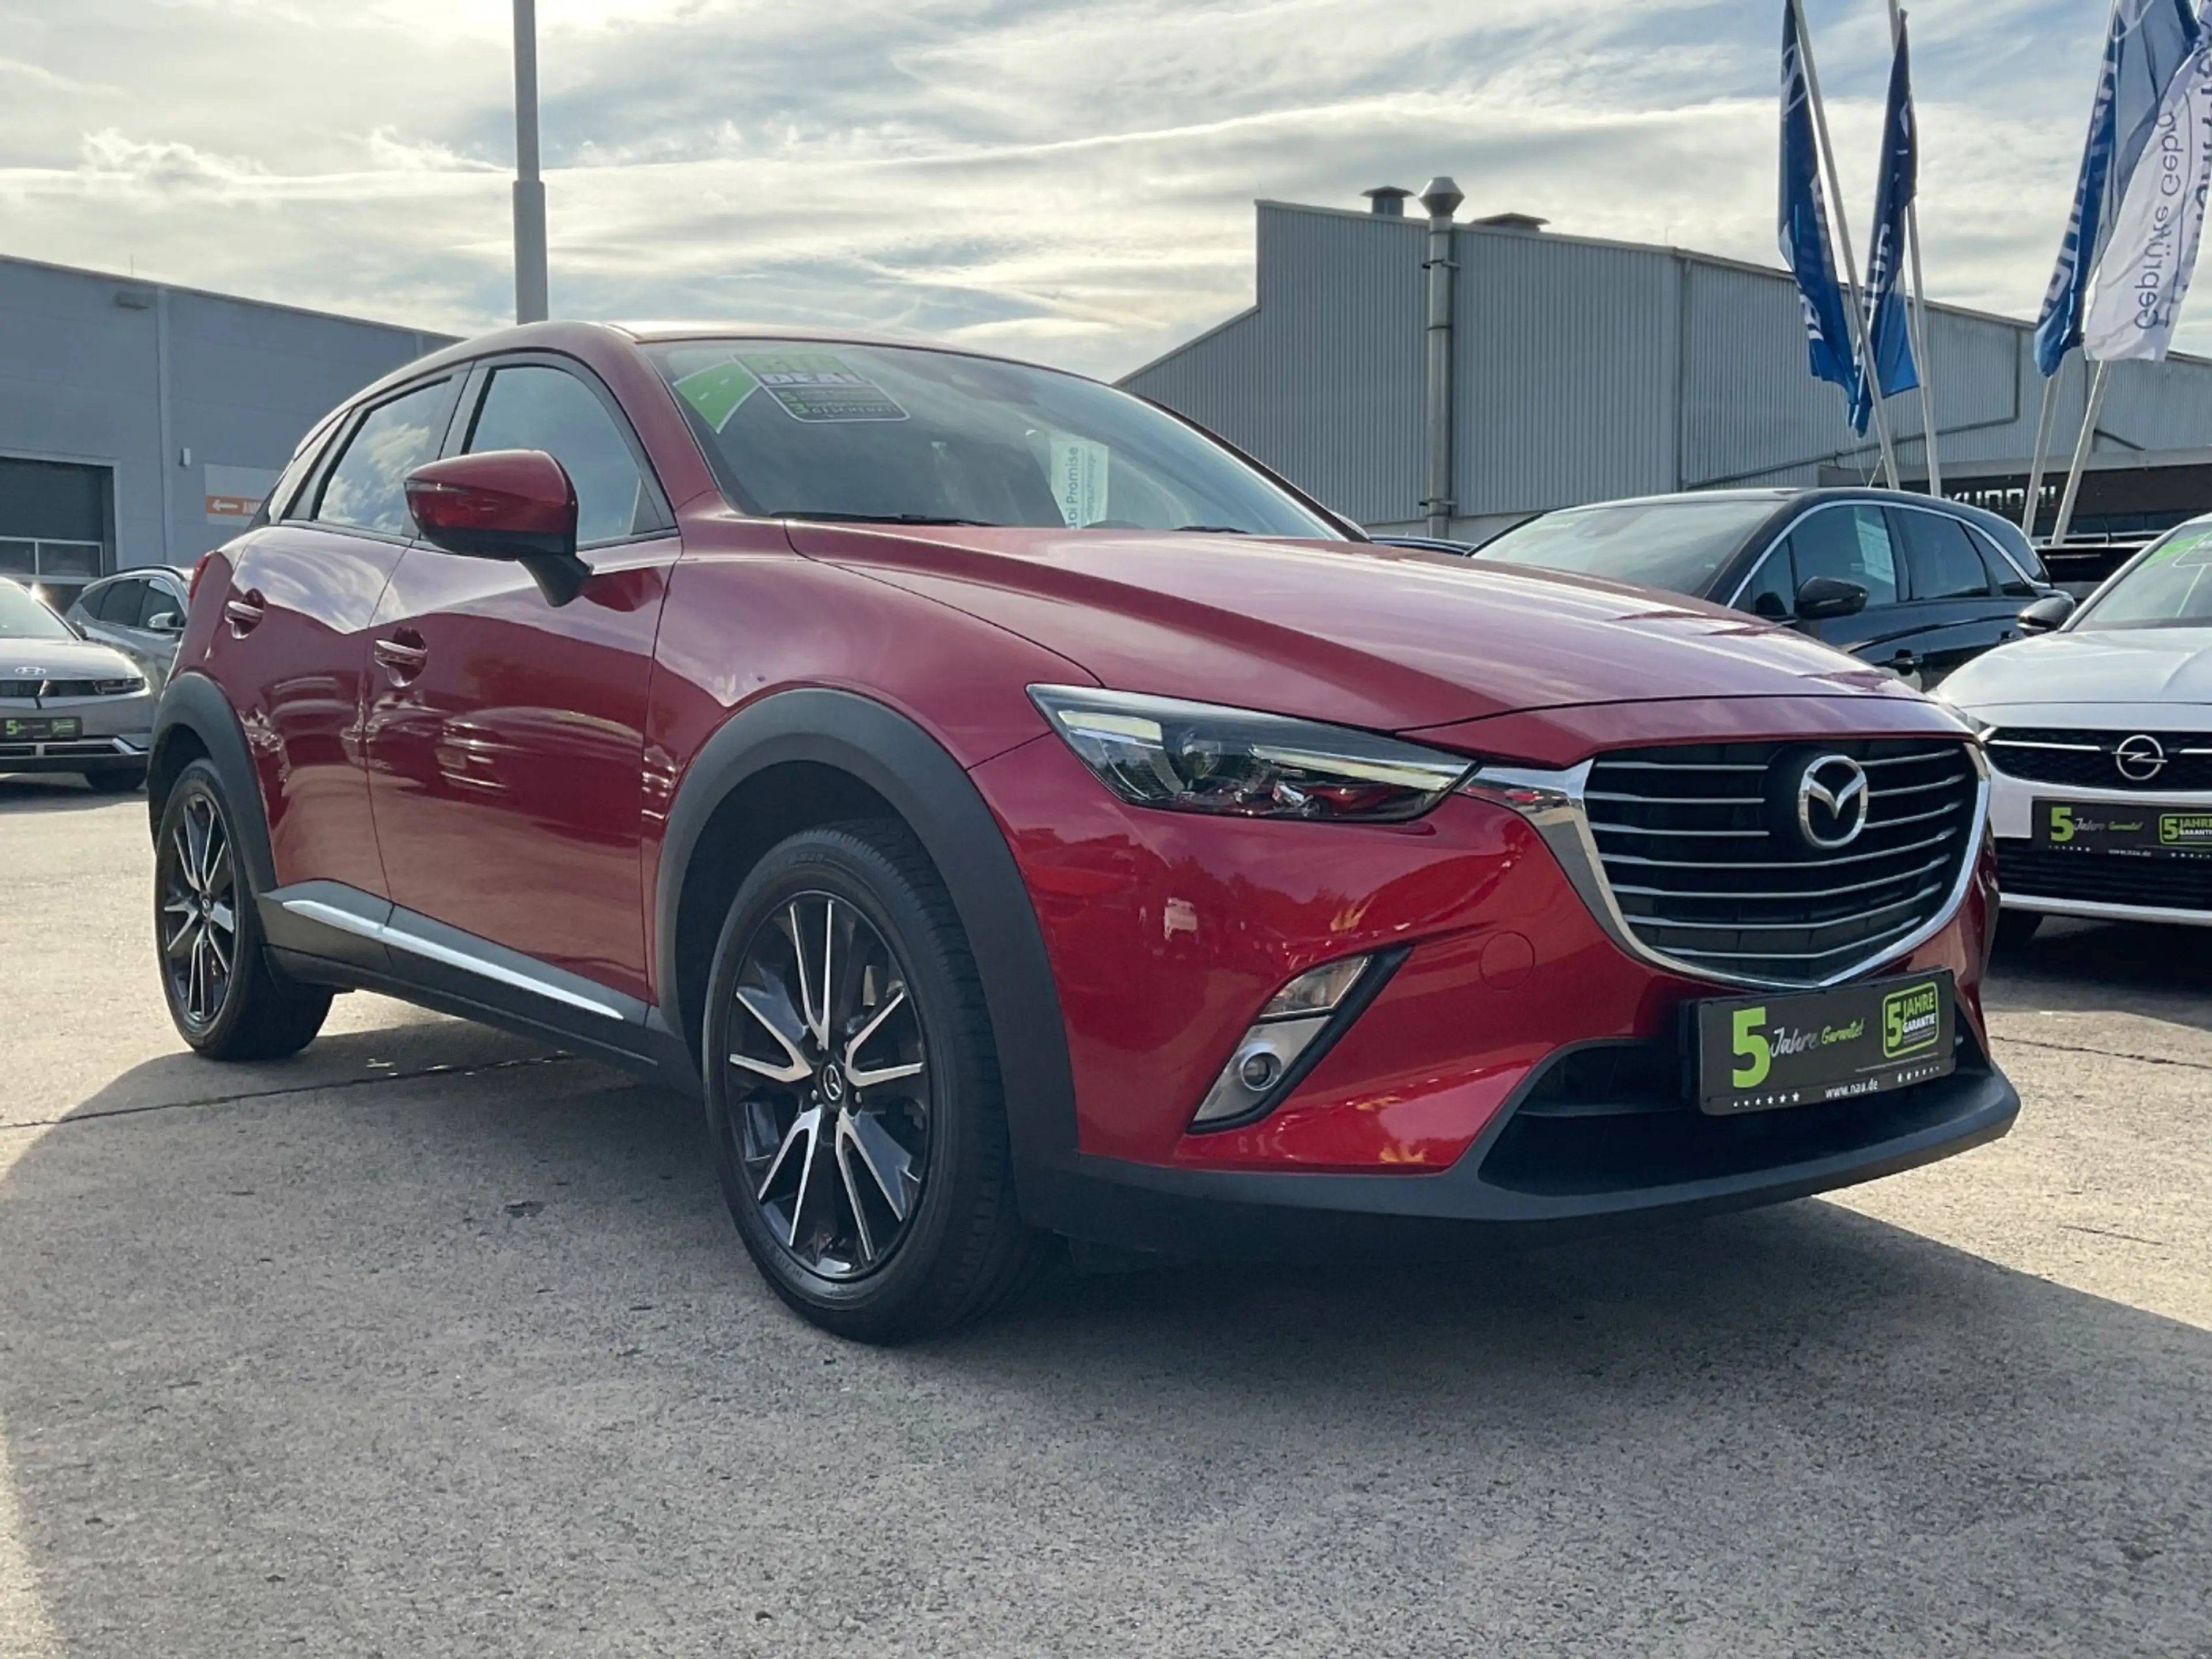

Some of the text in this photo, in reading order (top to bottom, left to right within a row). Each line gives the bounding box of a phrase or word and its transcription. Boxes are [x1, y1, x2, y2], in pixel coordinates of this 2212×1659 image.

[1065, 446, 1079, 504] Promise
[2051, 807, 2074, 842] 5
[2163, 818, 2179, 840] 5
[1903, 991, 1934, 1022] JAHRE
[1903, 1013, 1935, 1033] GARANTIE
[1888, 1002, 1903, 1047] 5
[1733, 1007, 1771, 1088] 5
[1770, 1027, 1819, 1058] Jahre
